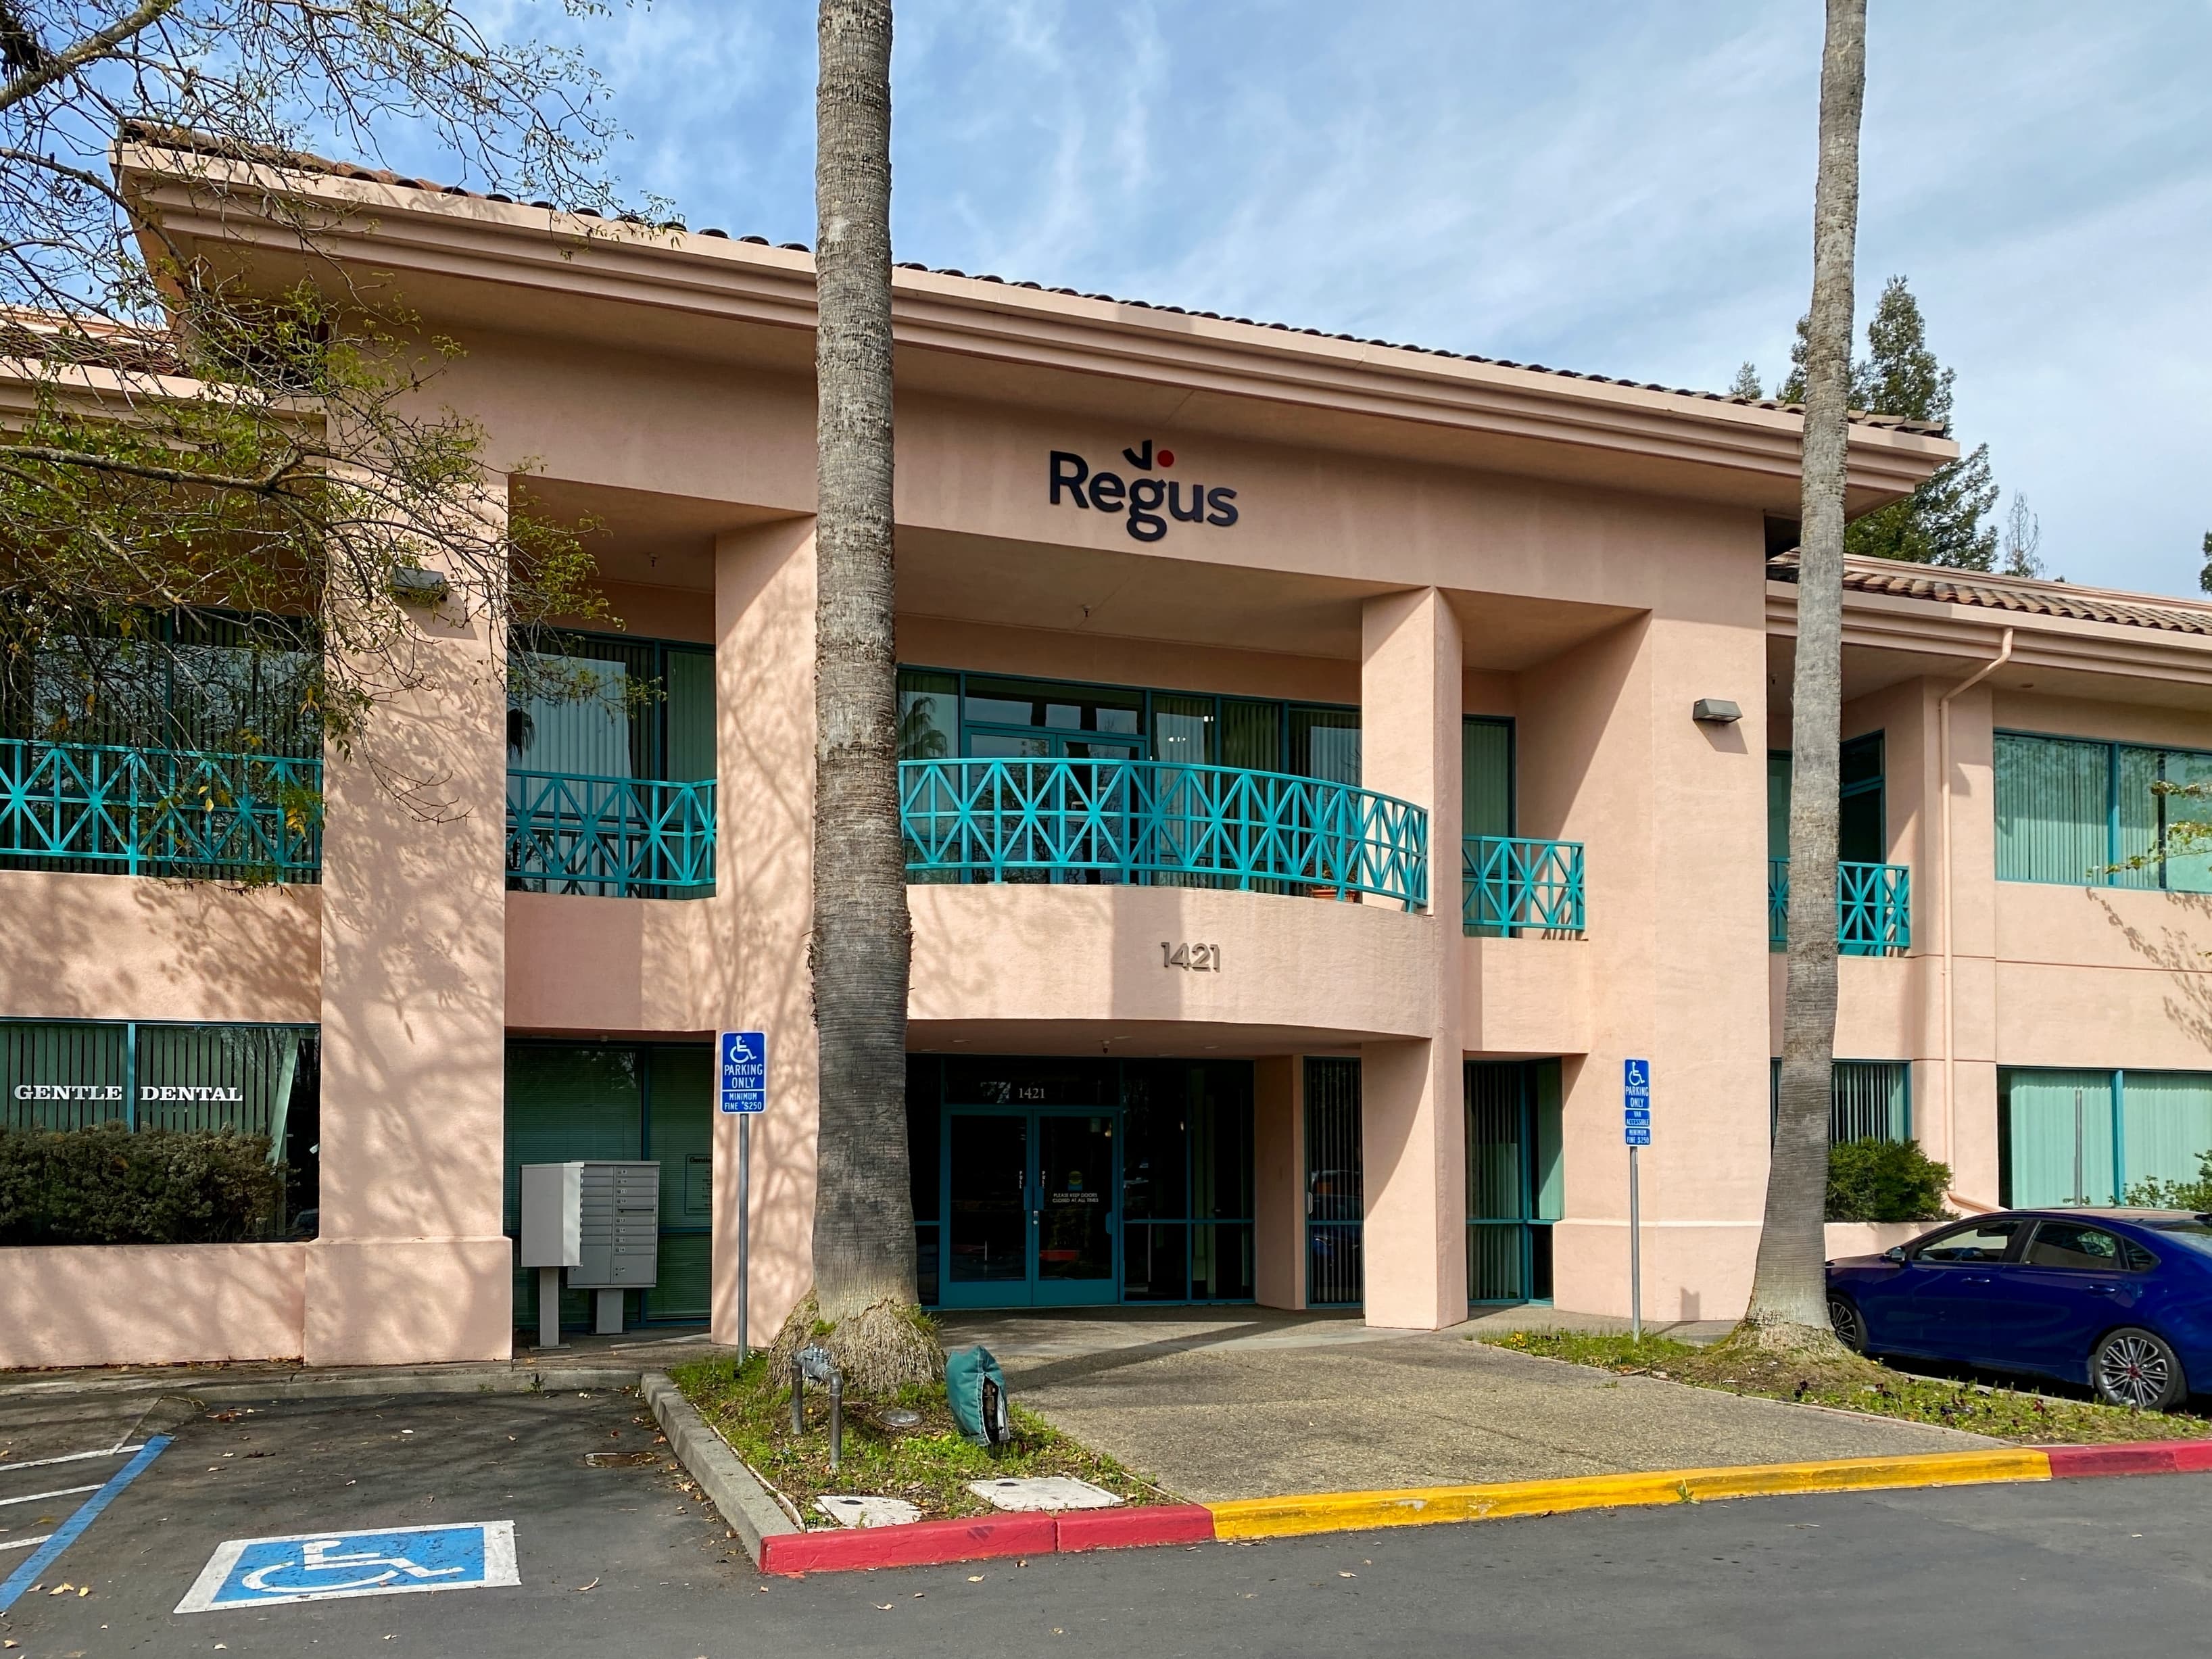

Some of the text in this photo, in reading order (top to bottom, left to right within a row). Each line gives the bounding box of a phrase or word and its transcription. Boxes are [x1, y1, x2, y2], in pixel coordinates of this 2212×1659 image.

[1050, 450, 1239, 542] Regus
[1161, 942, 1220, 973] 1421
[724, 1064, 763, 1076] PARKING
[731, 1077, 755, 1088] ONLY
[14, 1085, 243, 1102] GENTLE DENTAL
[729, 1092, 757, 1101] MINIMUM
[1018, 1087, 1045, 1099] 1421
[1625, 1086, 1649, 1097] PARKING
[724, 1102, 738, 1110] FINE
[1630, 1097, 1644, 1108] ONLY
